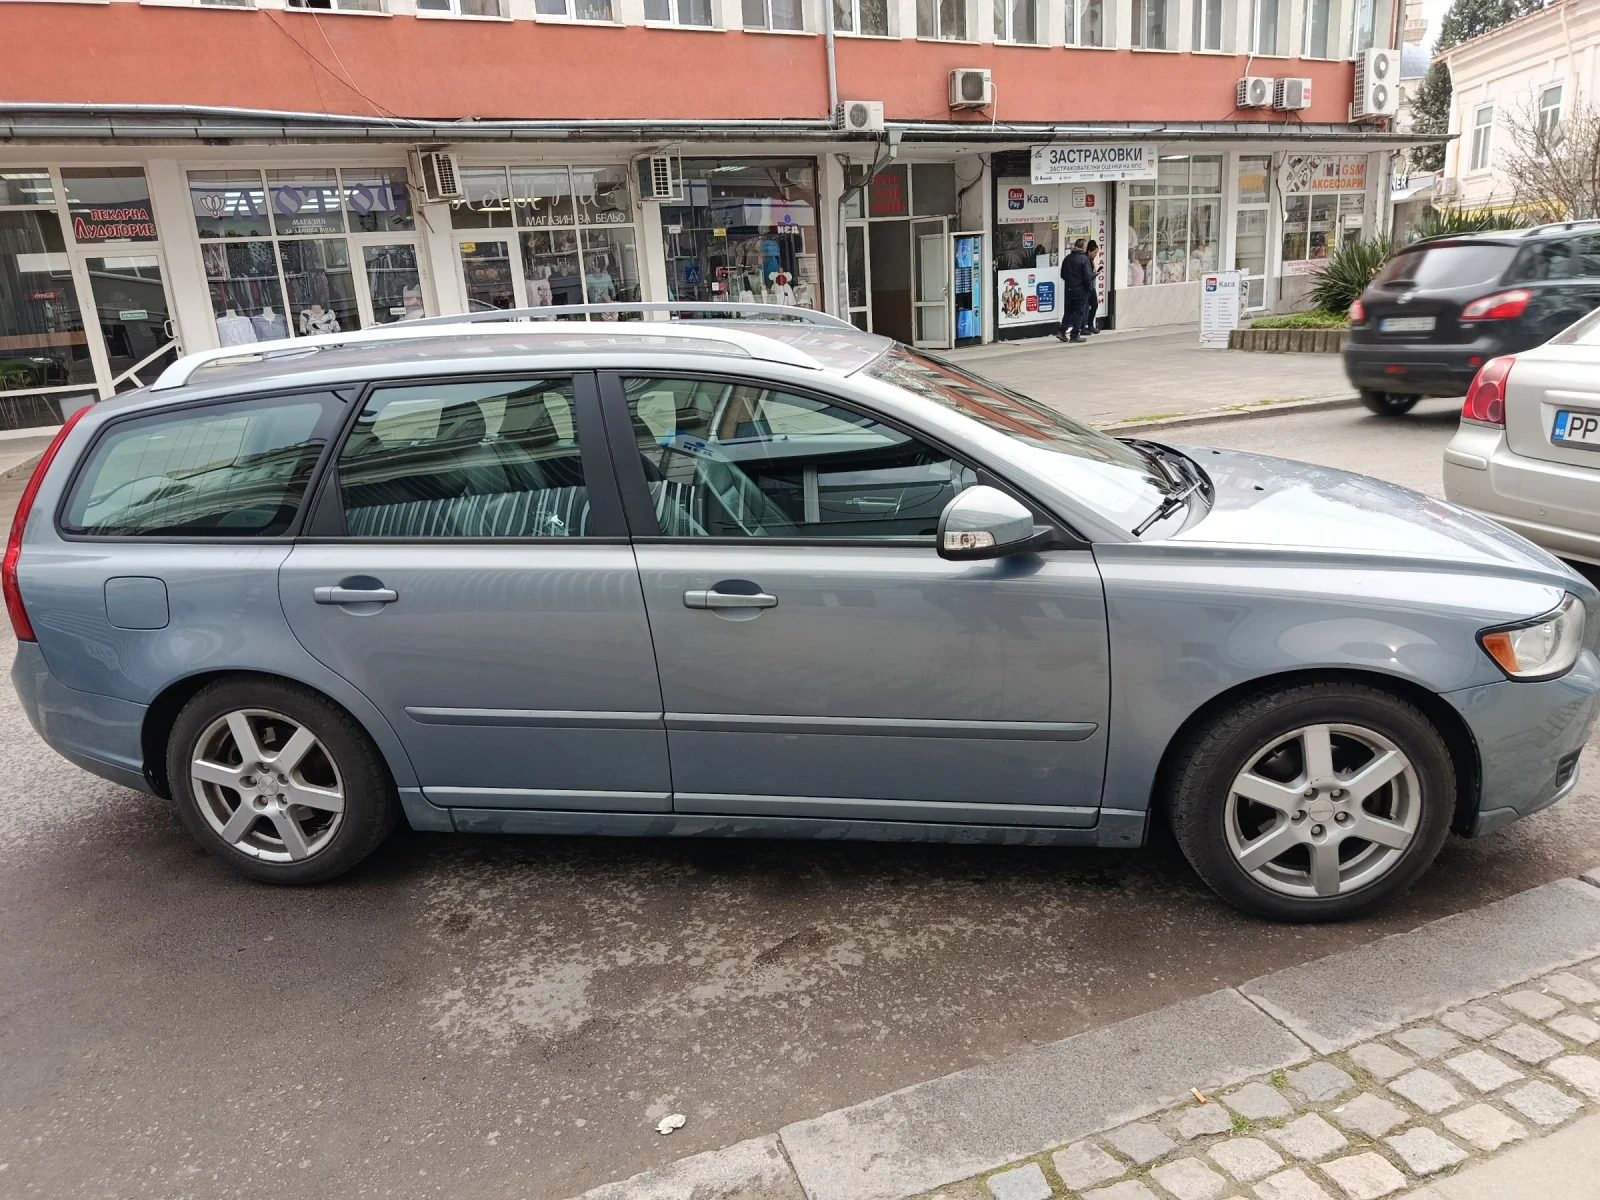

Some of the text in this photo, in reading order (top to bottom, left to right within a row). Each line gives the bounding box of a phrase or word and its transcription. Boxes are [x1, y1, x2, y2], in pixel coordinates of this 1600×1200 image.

[1049, 147, 1142, 164] ЗАСТРАХОВКИ
[1342, 163, 1364, 175] GSM
[1312, 178, 1363, 189] АКСЕСОАРИ
[1010, 190, 1022, 198] Easy
[1027, 194, 1048, 203] Каса
[233, 182, 406, 221] ЛОТОС
[1010, 201, 1021, 209] Pay
[90, 208, 148, 220] ПЕКАРНА
[525, 212, 626, 226] МАГАЗИН ЗА БЕЛЬО
[292, 218, 326, 226] МАГАЗИН
[1555, 428, 1565, 436] BG
